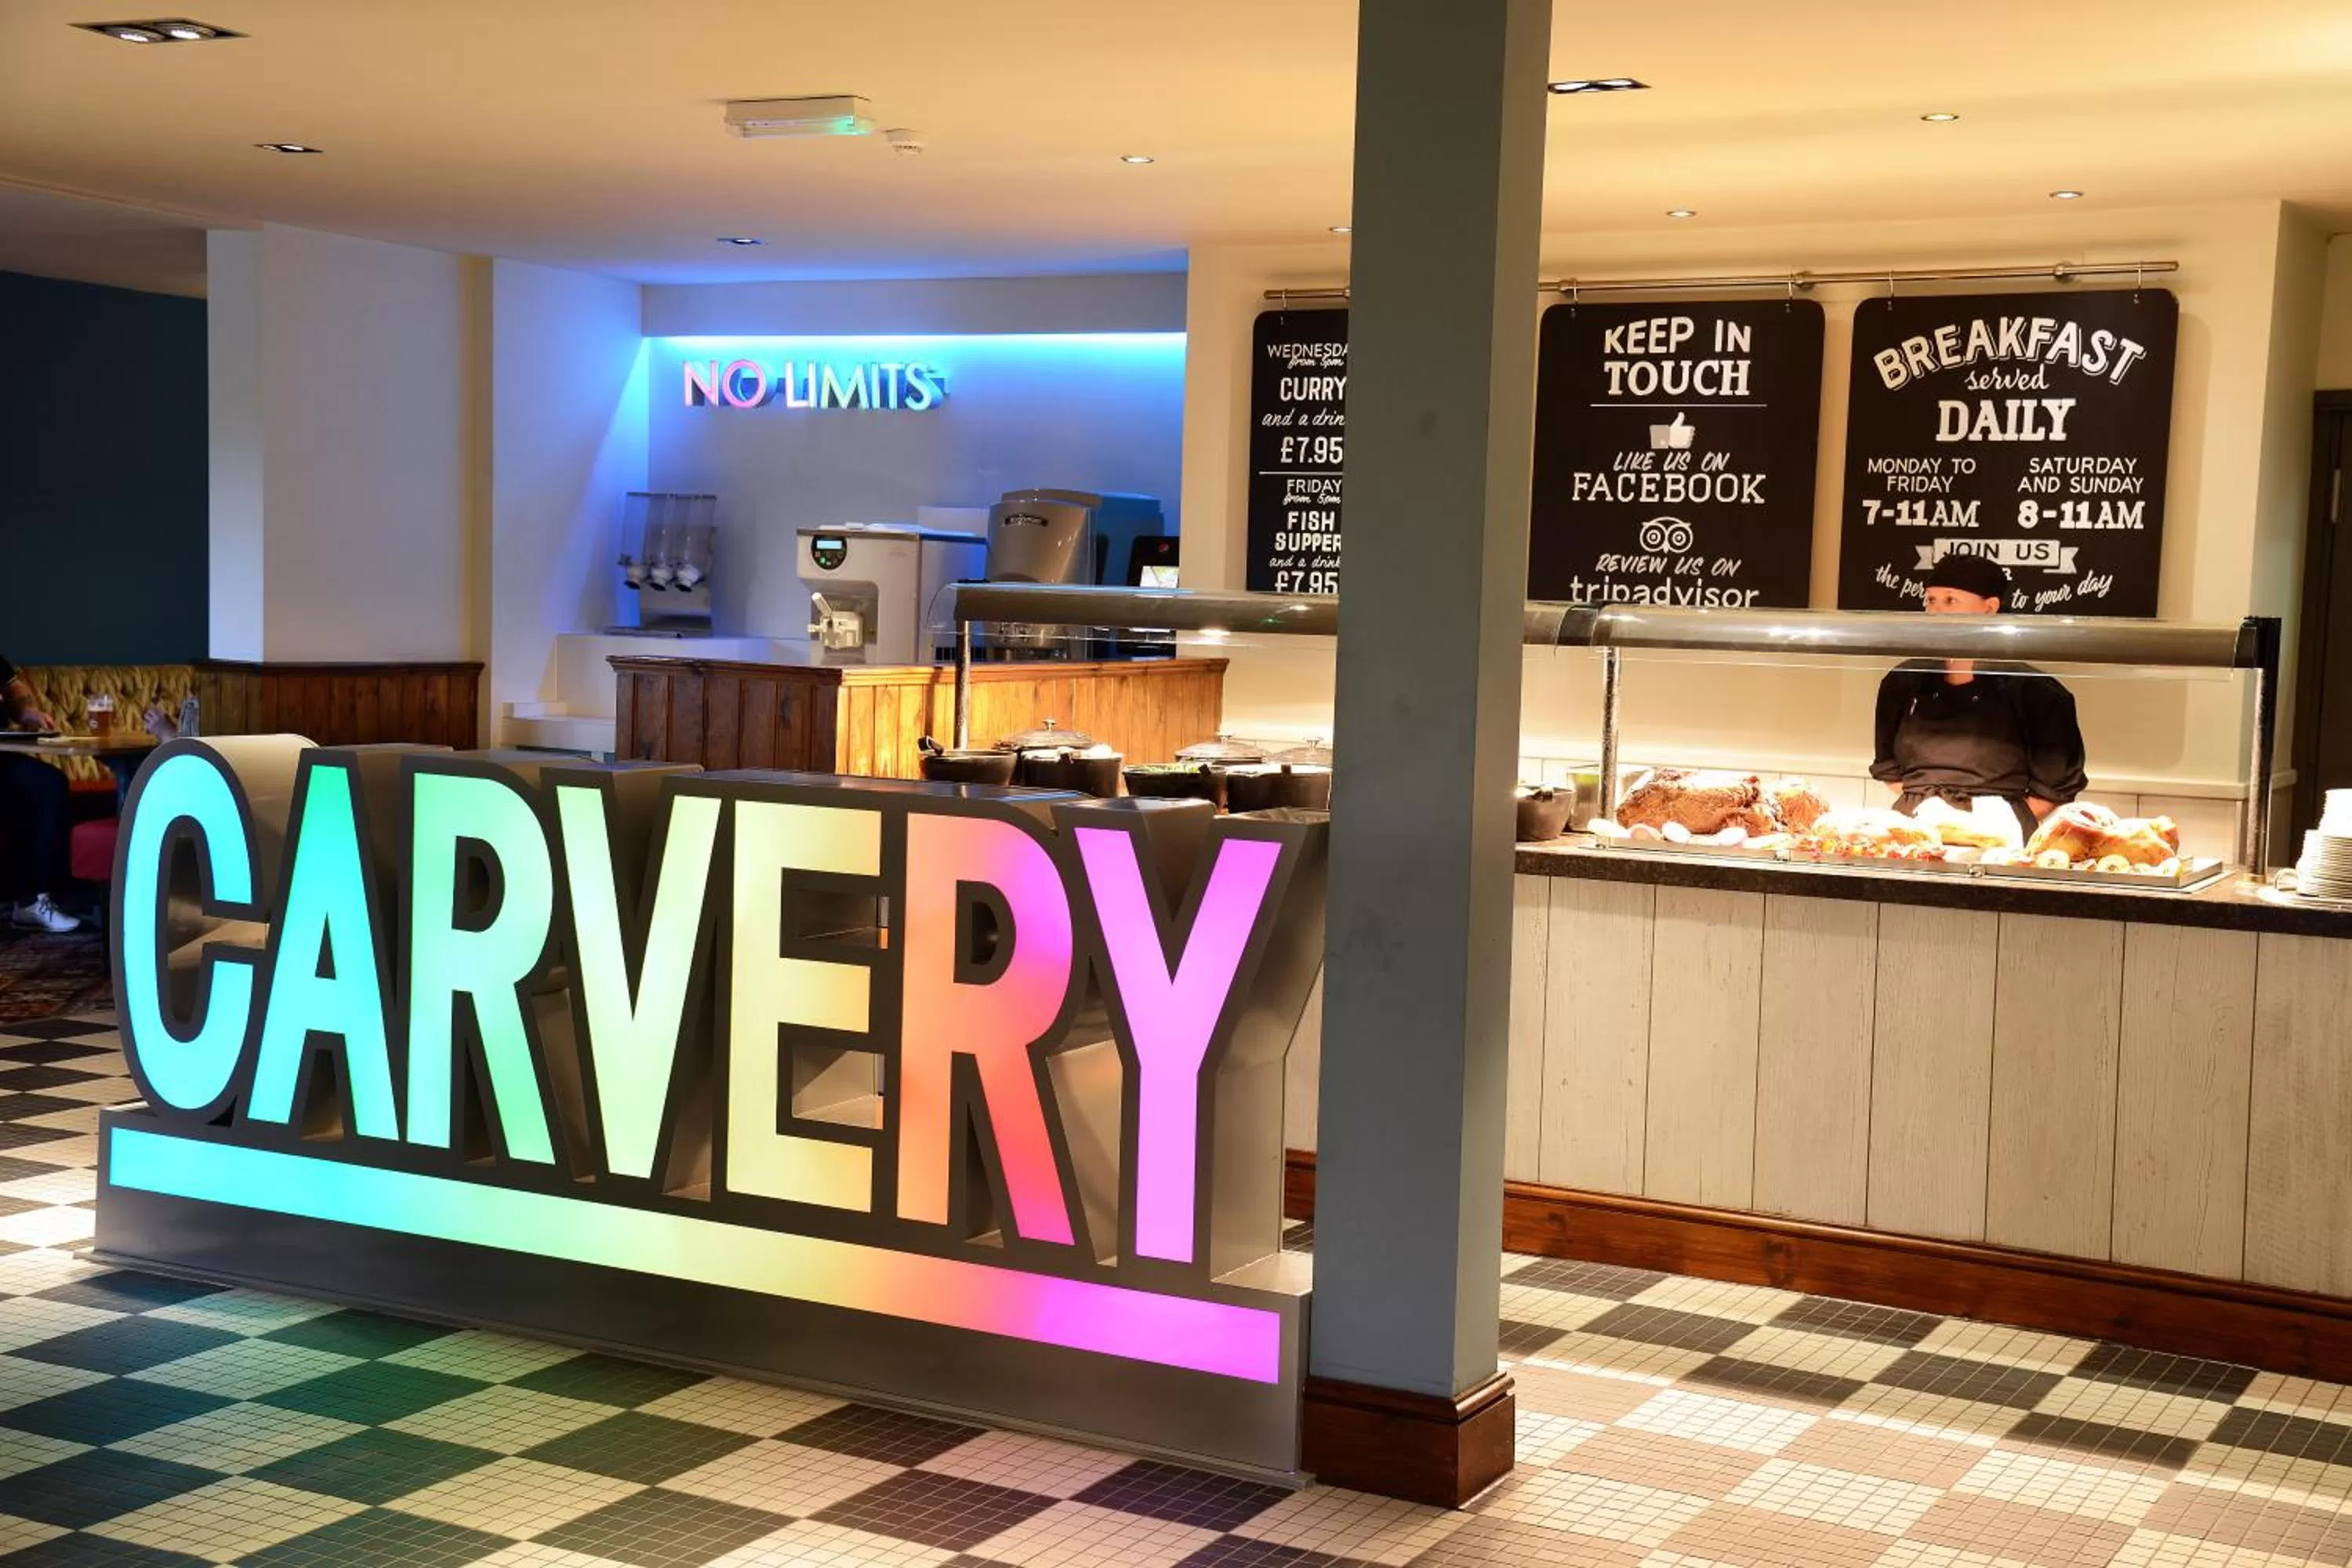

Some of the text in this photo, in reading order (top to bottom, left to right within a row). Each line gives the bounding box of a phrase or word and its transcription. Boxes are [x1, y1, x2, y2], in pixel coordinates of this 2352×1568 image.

[1603, 316, 1751, 354] KEEP IN
[1267, 343, 1348, 358] WEDNESDA
[1287, 355, 1316, 369] from
[1872, 317, 2147, 390] BREAKFAST
[683, 360, 939, 411] NO LIMITS
[1279, 376, 1348, 402] CURRY
[1603, 359, 1751, 396] TOUCH
[1965, 364, 2050, 391] served
[1261, 408, 1346, 426] and a drin
[1935, 397, 2077, 442] DAILY
[1280, 435, 1344, 465] £7.95
[1613, 451, 1730, 473] LIKE US ON
[1867, 457, 1976, 474] MONDAY TO
[2028, 456, 2137, 474] SATURDAY
[1287, 479, 1342, 494] FRIDAY
[1572, 470, 1766, 504] FACEBOOK
[1887, 475, 1954, 493] FRIDAY
[2017, 476, 2144, 495] AND SUNDAY
[1287, 510, 1335, 532] FISH
[1862, 499, 1981, 528] 7-11AM
[2017, 499, 2146, 530] 8-11AM
[1274, 532, 1341, 553] SUPPER
[1943, 542, 2050, 561] JOIN US
[1269, 554, 1294, 568] and
[1298, 557, 1307, 567] a
[1595, 552, 1742, 578] REVIEW US ON
[1274, 571, 1338, 594] £795
[1875, 563, 1900, 589] the
[1570, 575, 1761, 608] tripadvisor
[2011, 568, 2114, 612] to your day
[122, 753, 1283, 1264] CARVERY
